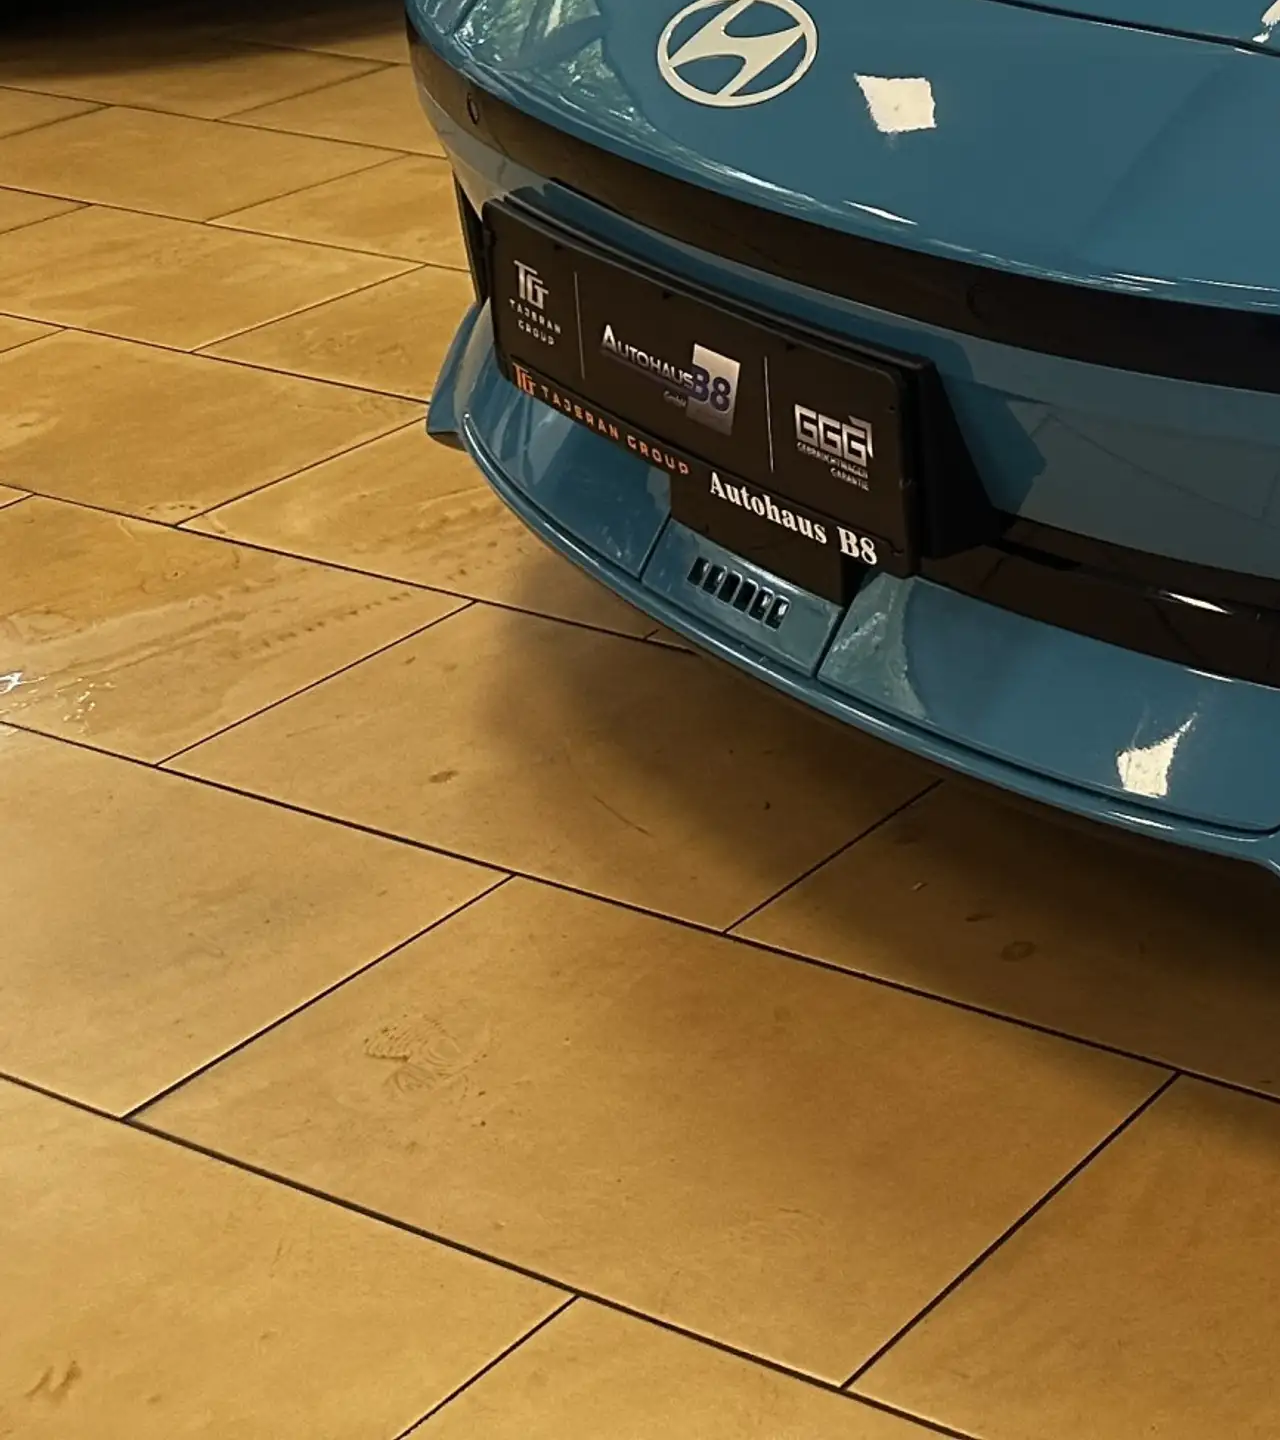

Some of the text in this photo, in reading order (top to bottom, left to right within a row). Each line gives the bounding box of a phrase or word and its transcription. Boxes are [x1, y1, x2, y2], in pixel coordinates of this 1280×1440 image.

[517, 318, 556, 346] GROUP
[540, 384, 620, 441] TAJERAN
[626, 433, 690, 475] GROUP
[709, 471, 878, 566] Autohaus B8
